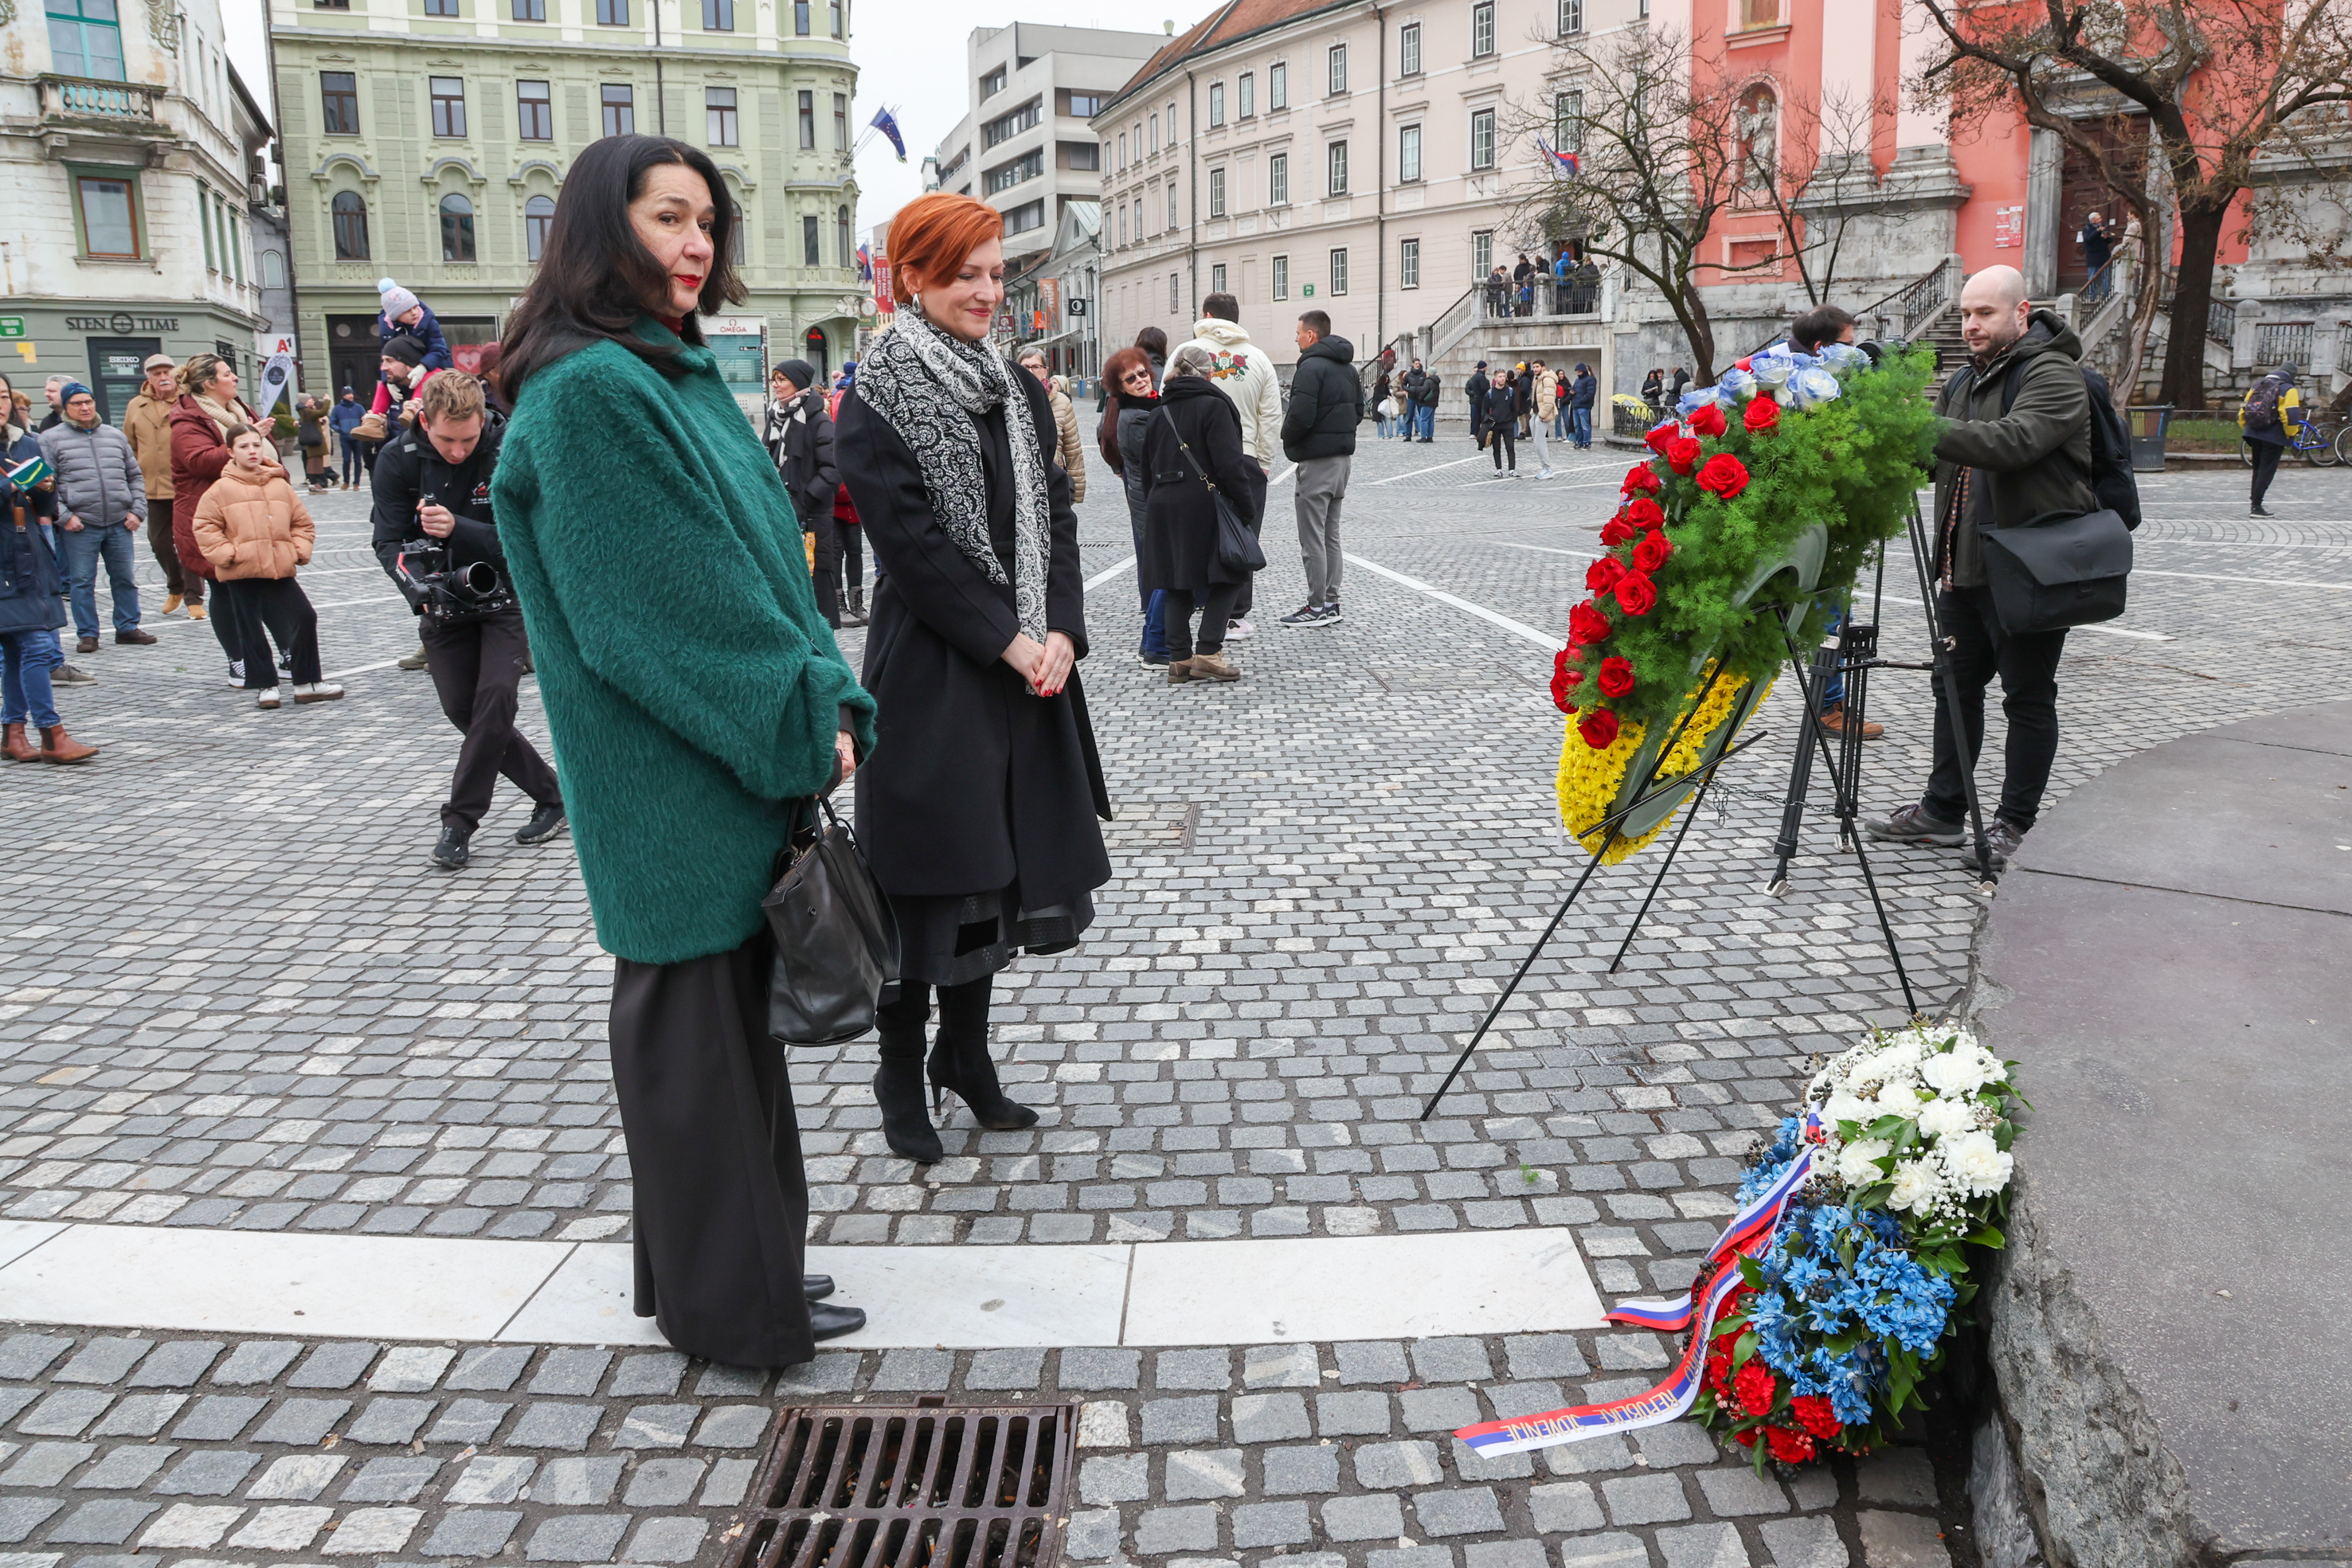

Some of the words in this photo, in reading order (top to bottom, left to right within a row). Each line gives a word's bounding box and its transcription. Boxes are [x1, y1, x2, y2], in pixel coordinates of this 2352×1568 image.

[65, 317, 106, 330] STEN
[138, 319, 179, 330] TIME
[276, 337, 292, 353] A1
[1706, 1279, 1720, 1307] ZA
[1684, 1312, 1708, 1385] KULTURO
[1592, 1389, 1681, 1428] REPUBLIKE
[1500, 1414, 1587, 1446] SLOVENIJE
